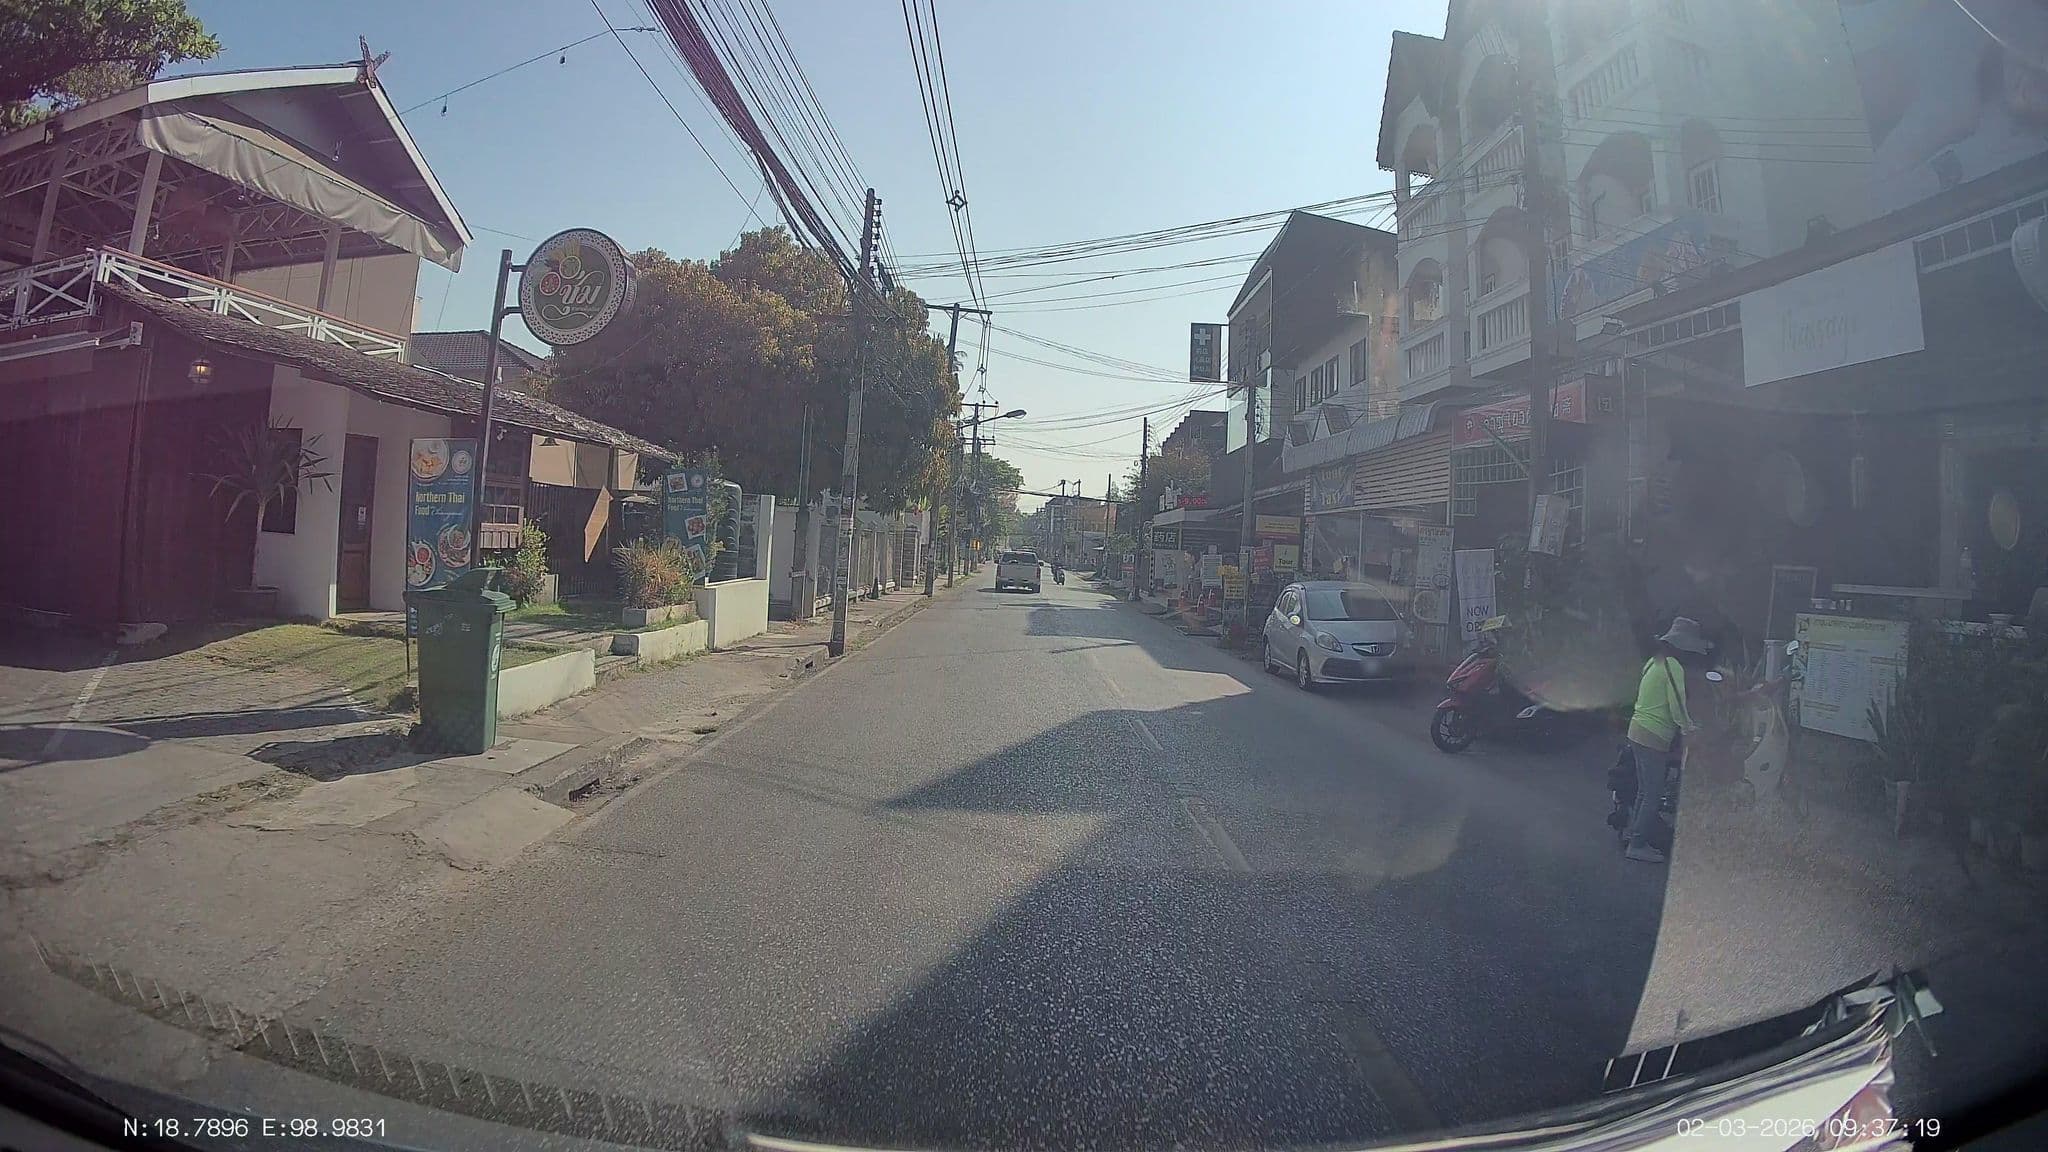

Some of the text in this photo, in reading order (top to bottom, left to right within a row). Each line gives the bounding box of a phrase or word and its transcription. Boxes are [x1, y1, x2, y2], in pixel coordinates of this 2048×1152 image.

[448, 492, 465, 503] Thai
[414, 505, 430, 516] Food
[1154, 531, 1177, 543] 药店
[1466, 606, 1489, 616] NOW
